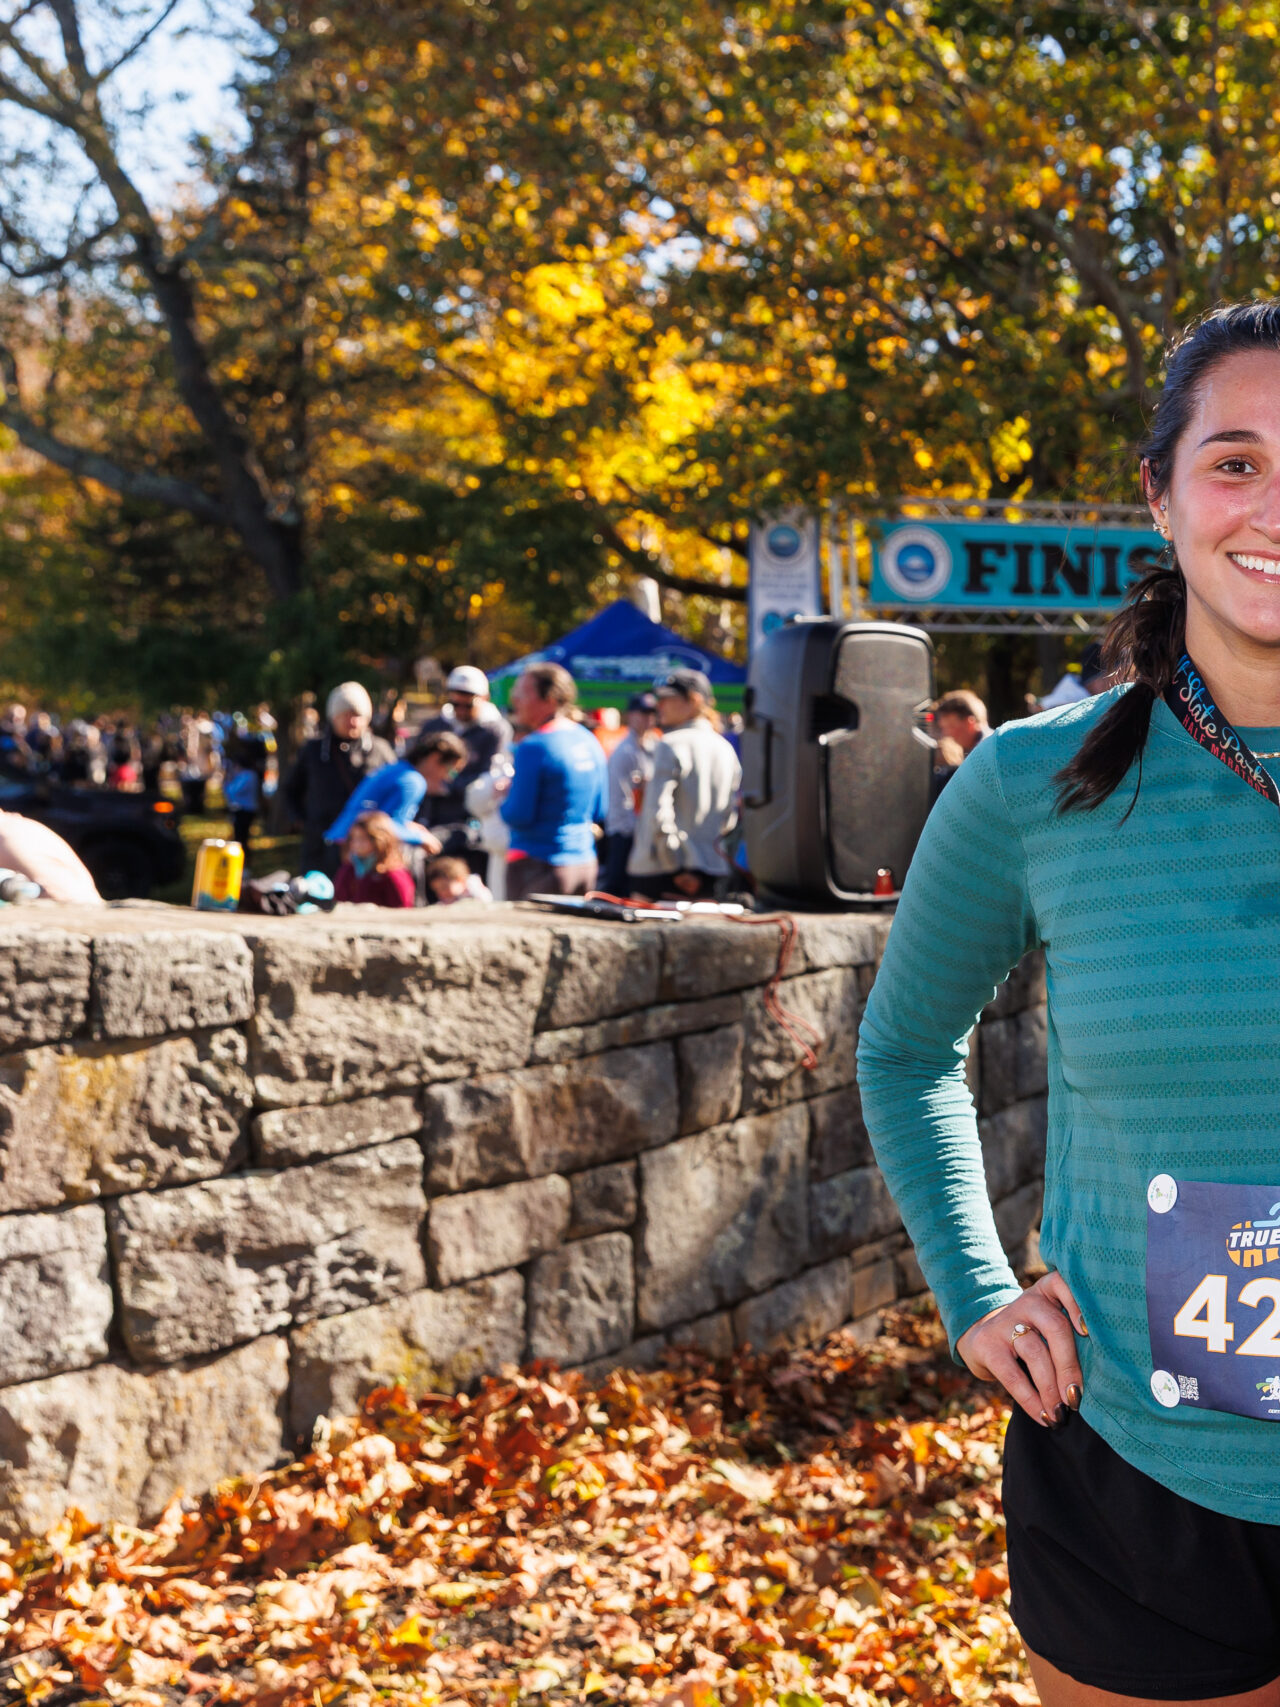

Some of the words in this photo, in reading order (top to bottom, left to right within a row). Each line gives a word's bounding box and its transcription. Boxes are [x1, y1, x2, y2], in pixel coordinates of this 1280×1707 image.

[1179, 671, 1219, 739] State
[1219, 726, 1268, 789] Park
[1182, 714, 1206, 745] HALF
[1210, 743, 1269, 799] MARATHON
